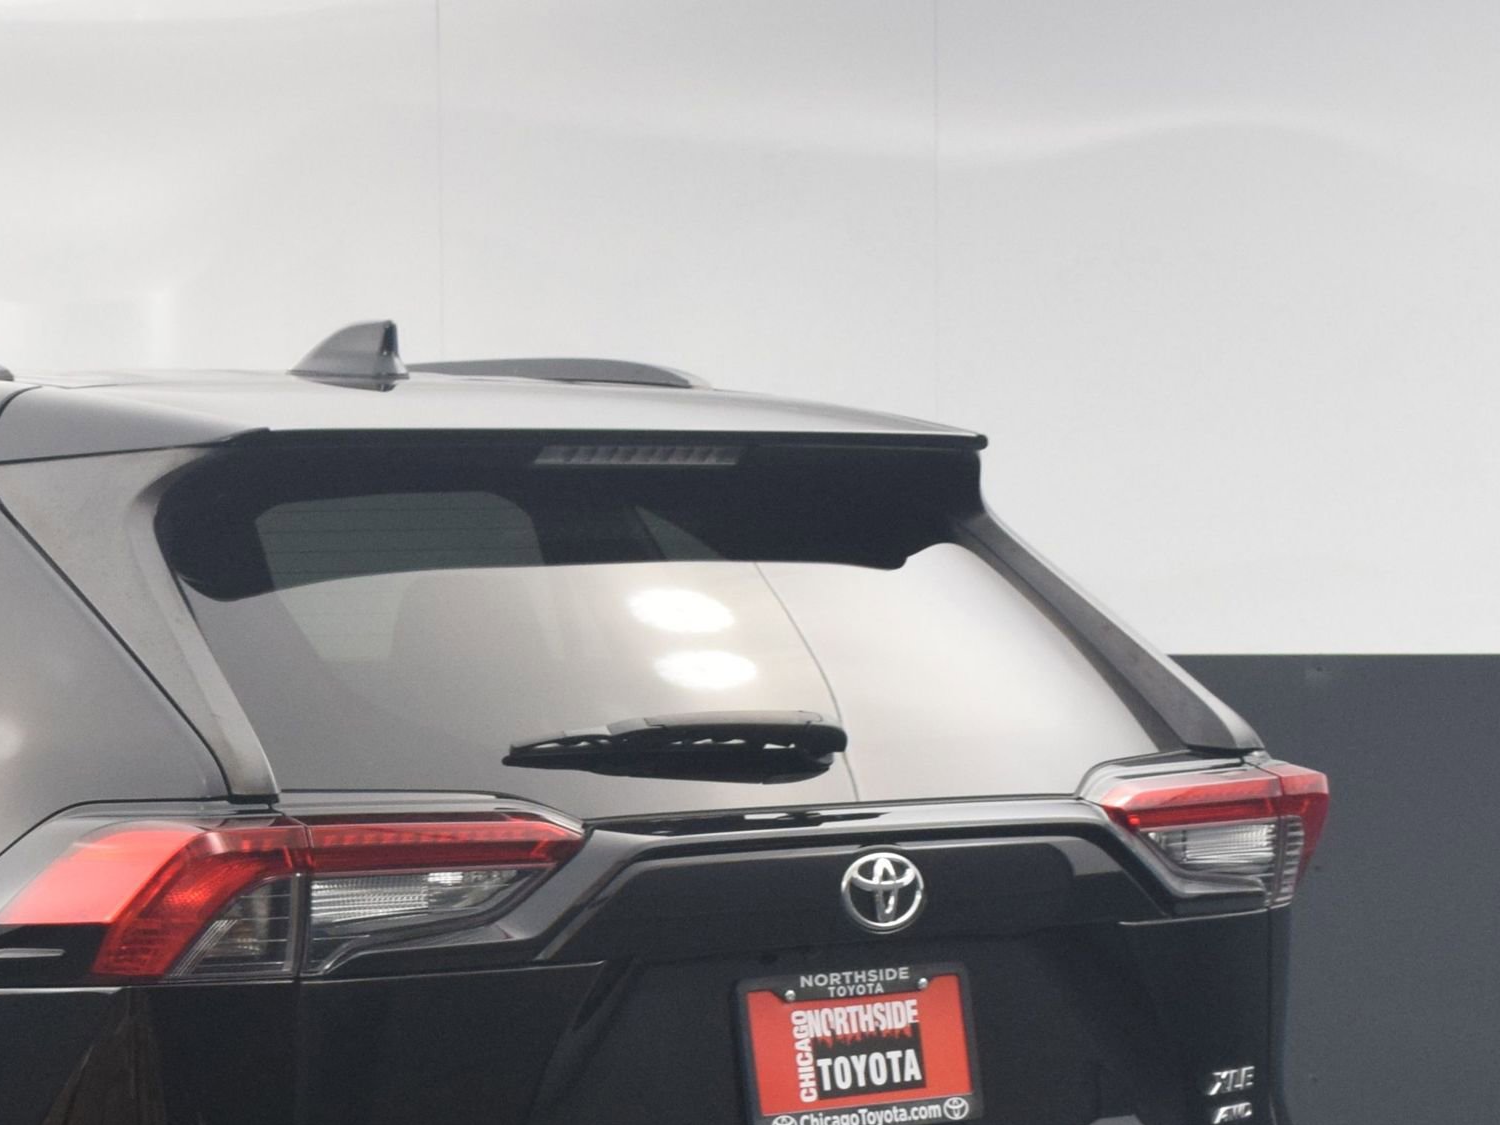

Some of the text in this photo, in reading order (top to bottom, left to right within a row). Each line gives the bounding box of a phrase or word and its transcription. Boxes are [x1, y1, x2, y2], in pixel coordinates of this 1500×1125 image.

[800, 966, 909, 988] NORTHSIDE
[828, 982, 884, 998] TOYOTA
[807, 999, 919, 1038] NORTHSIDE
[791, 1010, 818, 1102] CHICAGO
[817, 1048, 922, 1091] TOYOTA
